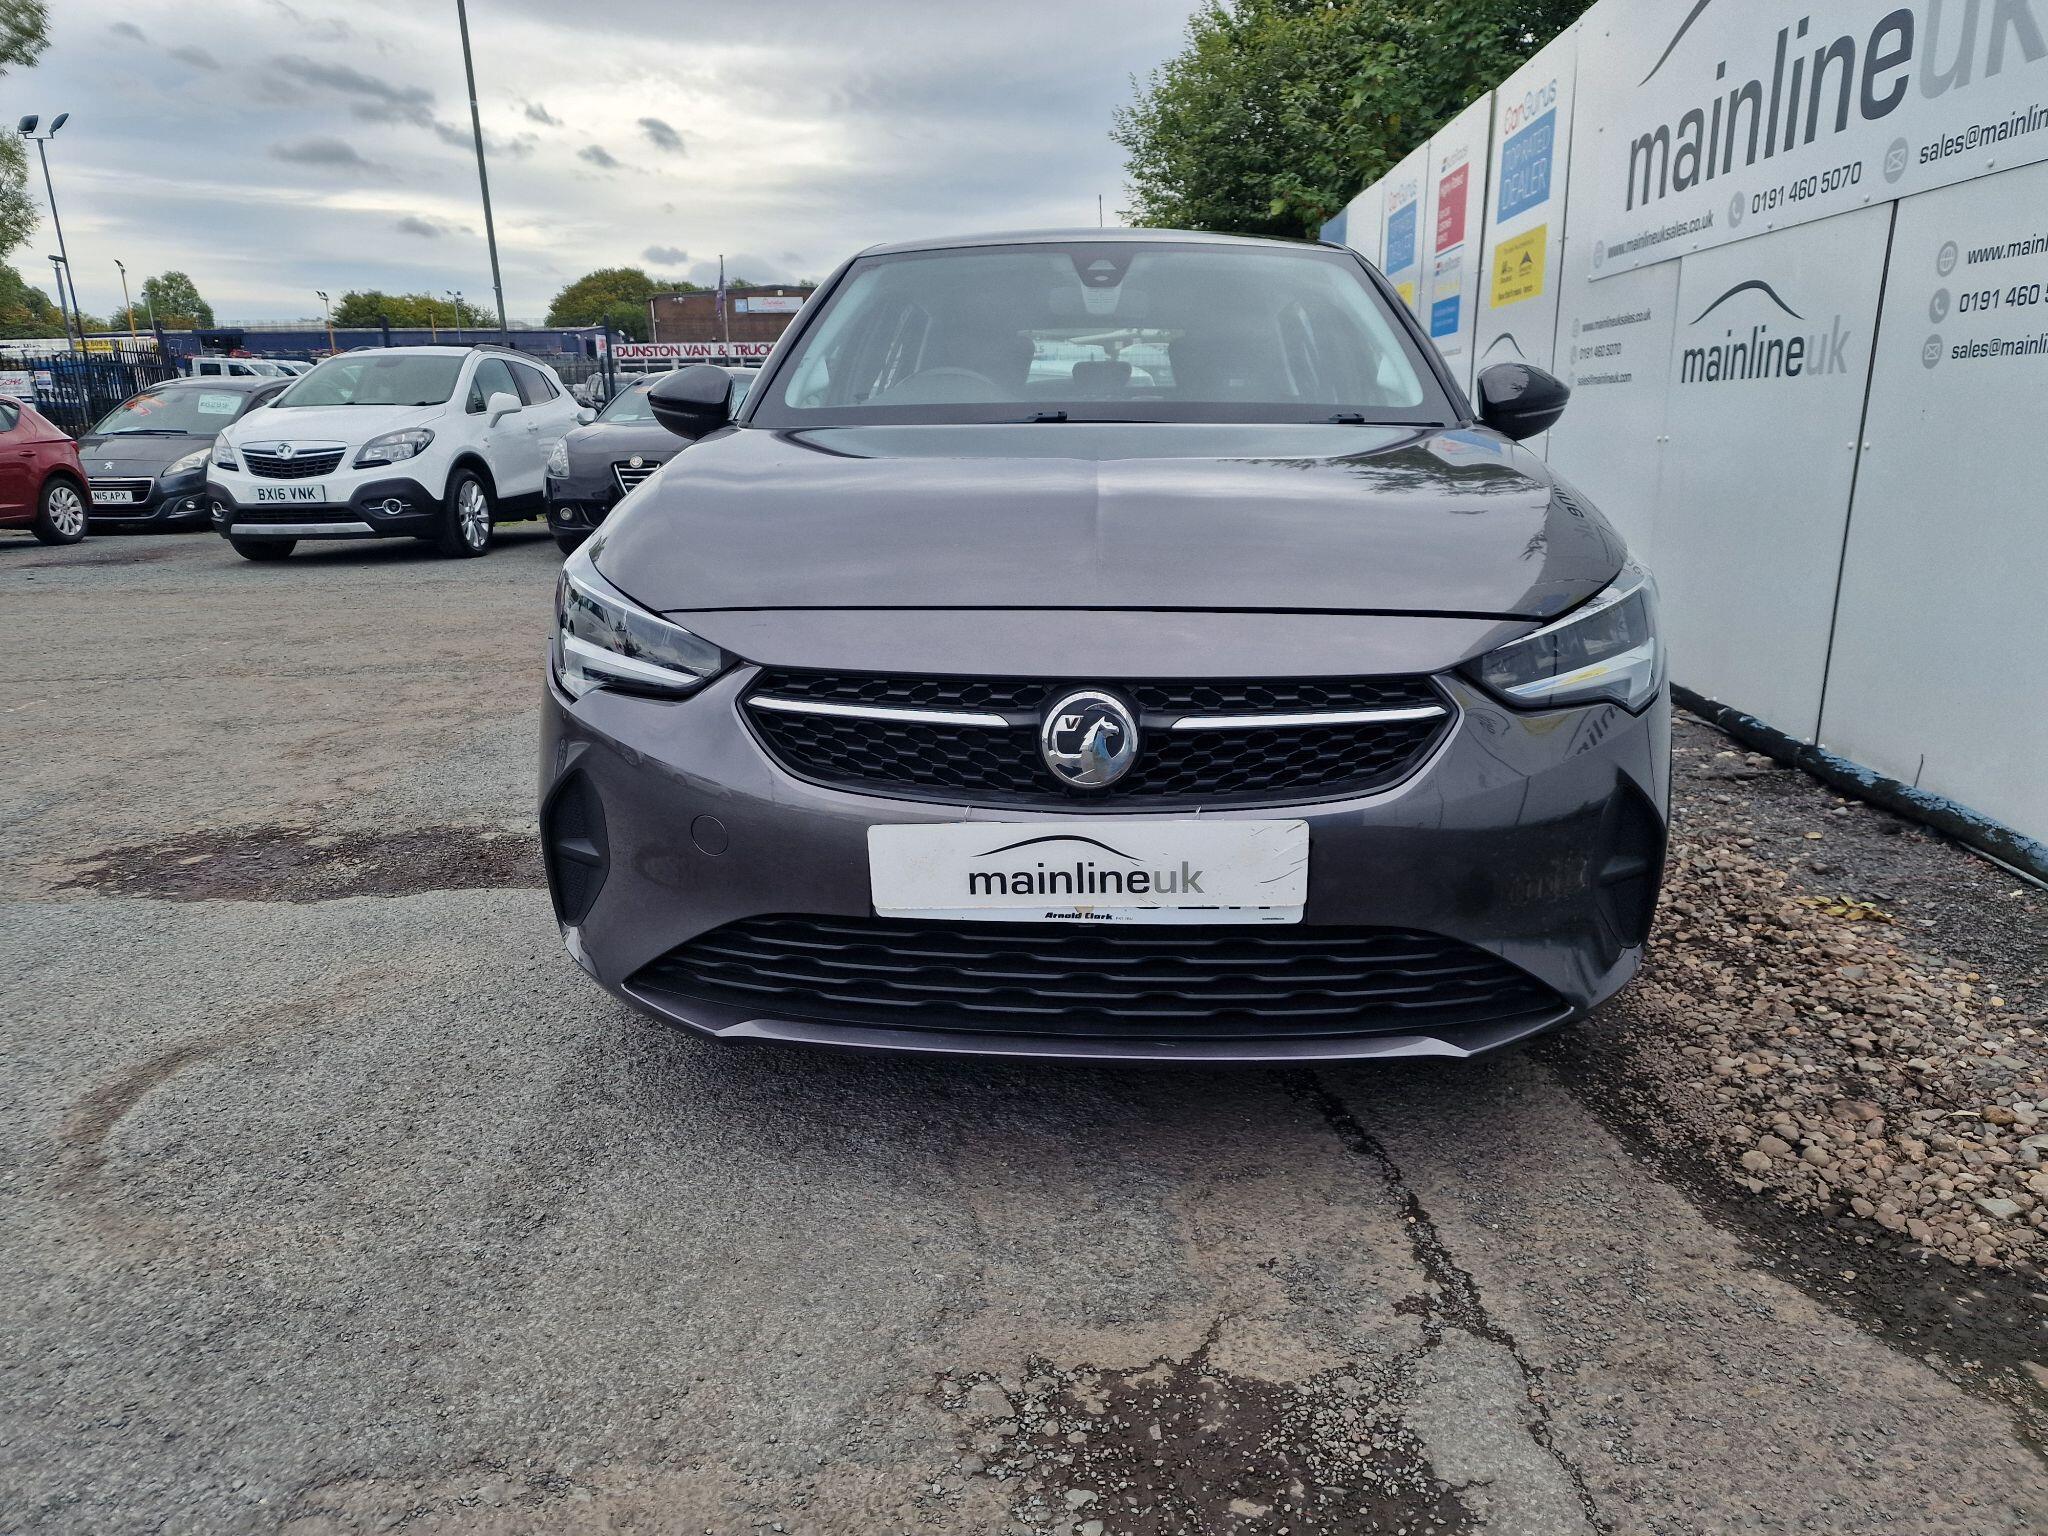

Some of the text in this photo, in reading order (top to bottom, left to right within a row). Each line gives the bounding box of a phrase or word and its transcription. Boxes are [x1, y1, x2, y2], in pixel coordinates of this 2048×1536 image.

[1501, 157, 1549, 211] DEALER
[1751, 161, 1862, 214] 0191 460 5070
[1959, 289, 2000, 313] 0191
[2005, 283, 2041, 307] 460
[615, 344, 681, 358] DUNSTON
[683, 344, 712, 358] VAN
[717, 344, 728, 357] &
[1681, 315, 1852, 384] mainlineuk
[110, 491, 127, 501] APX
[257, 487, 316, 501] BX16 VNK
[968, 860, 1205, 896] mainlineuk
[1044, 911, 1082, 919] Arnold
[1084, 911, 1113, 920] Clark
